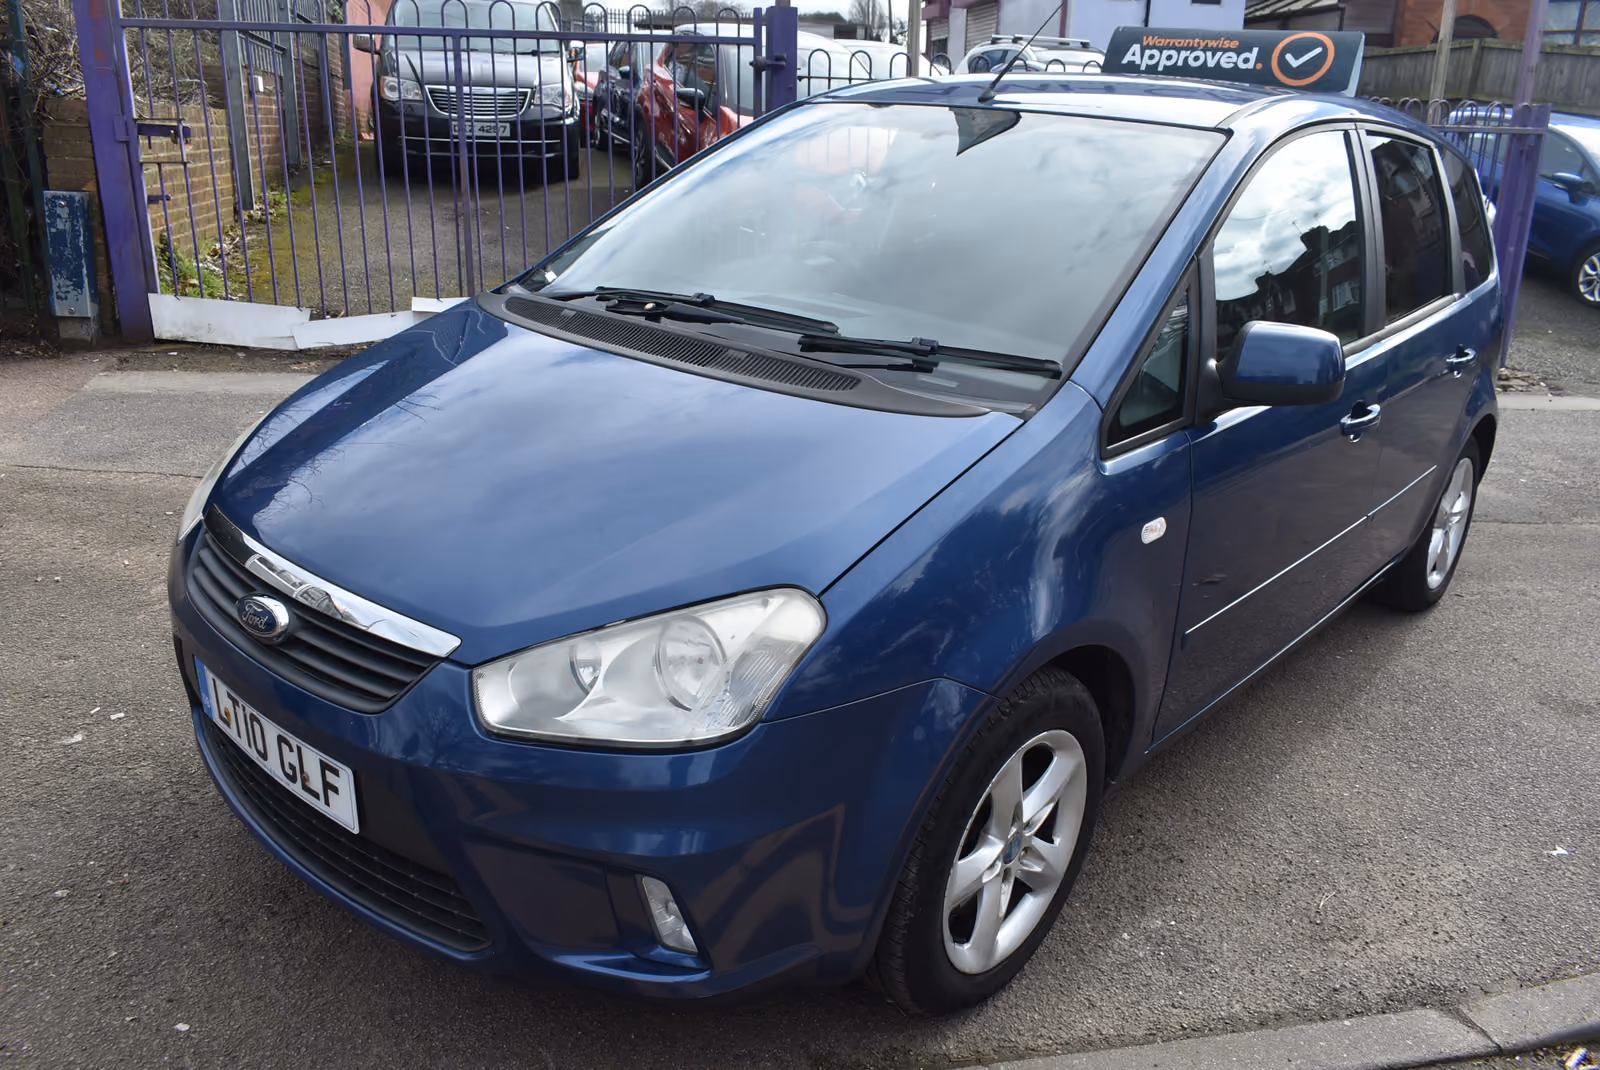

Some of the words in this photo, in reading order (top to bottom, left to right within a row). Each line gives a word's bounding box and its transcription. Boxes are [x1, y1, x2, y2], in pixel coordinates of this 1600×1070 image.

[1142, 36, 1239, 49] Warrantywise
[1121, 44, 1263, 71] Approved.
[241, 603, 268, 630] Ford
[212, 677, 268, 761] LT10
[277, 734, 341, 808] GLF
